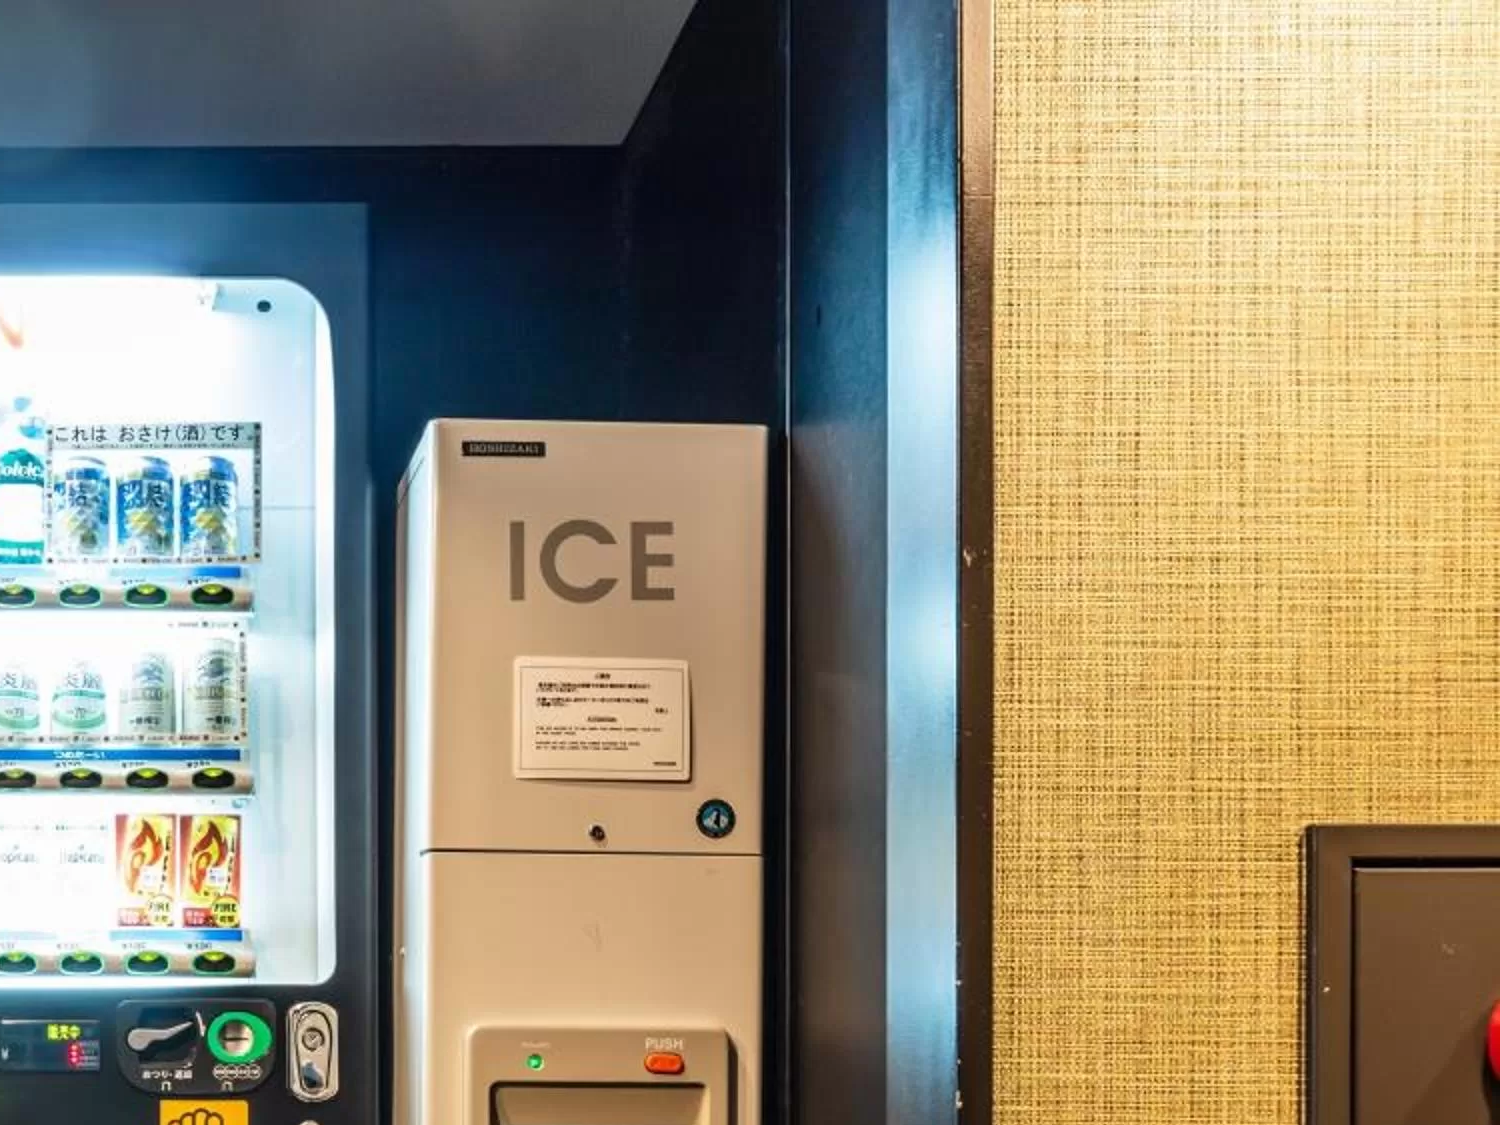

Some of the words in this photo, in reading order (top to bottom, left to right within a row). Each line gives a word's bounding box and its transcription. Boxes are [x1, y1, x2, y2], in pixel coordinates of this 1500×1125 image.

[54, 424, 109, 442] これは
[509, 520, 675, 604] ICE
[644, 1037, 684, 1051] PUSH
